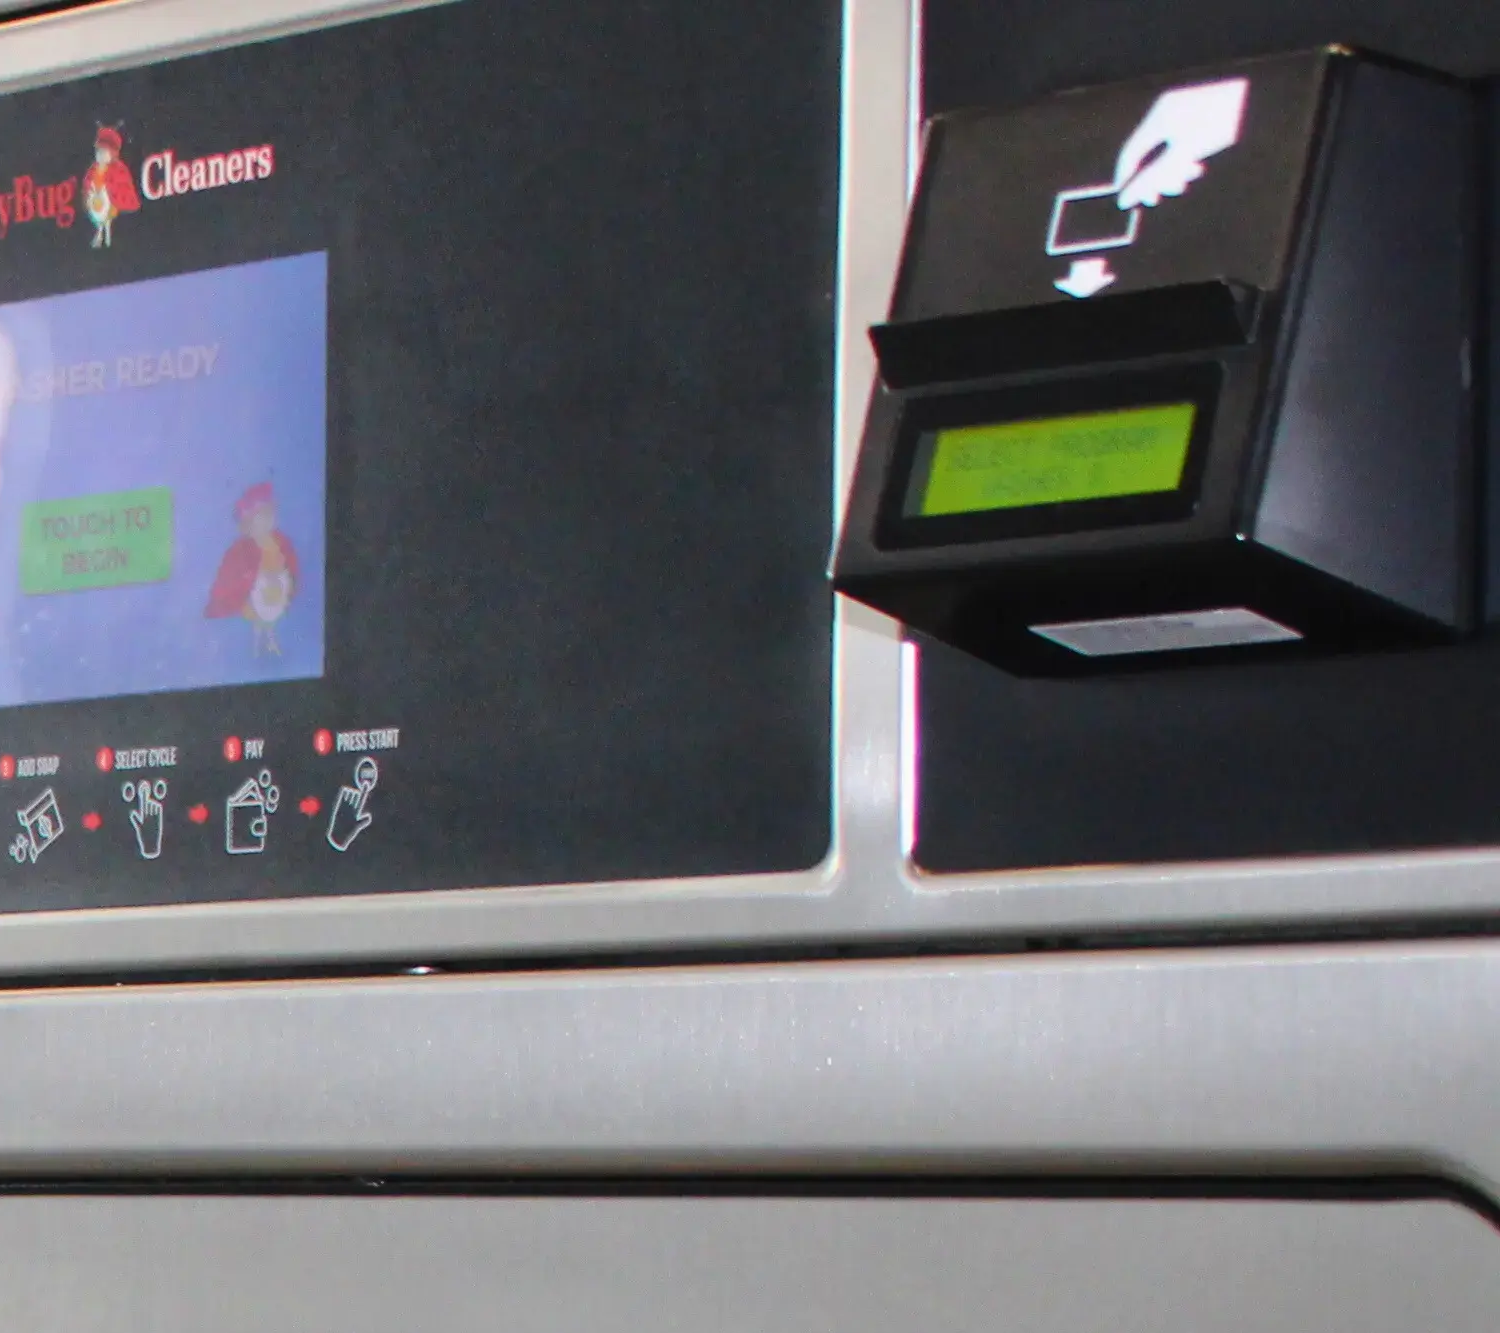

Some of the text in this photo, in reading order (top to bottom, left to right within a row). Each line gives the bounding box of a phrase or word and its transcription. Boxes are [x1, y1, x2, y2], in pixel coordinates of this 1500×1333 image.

[141, 144, 275, 201] Cleaners
[117, 343, 220, 389] READY
[41, 505, 151, 541] TOUCH TO
[244, 739, 265, 760] PAY
[337, 731, 368, 753] PRESS
[368, 728, 400, 750] START
[17, 757, 36, 777] ADD
[36, 754, 60, 775] SOAP
[115, 749, 149, 771] SELECT
[149, 746, 179, 767] CYCLE
